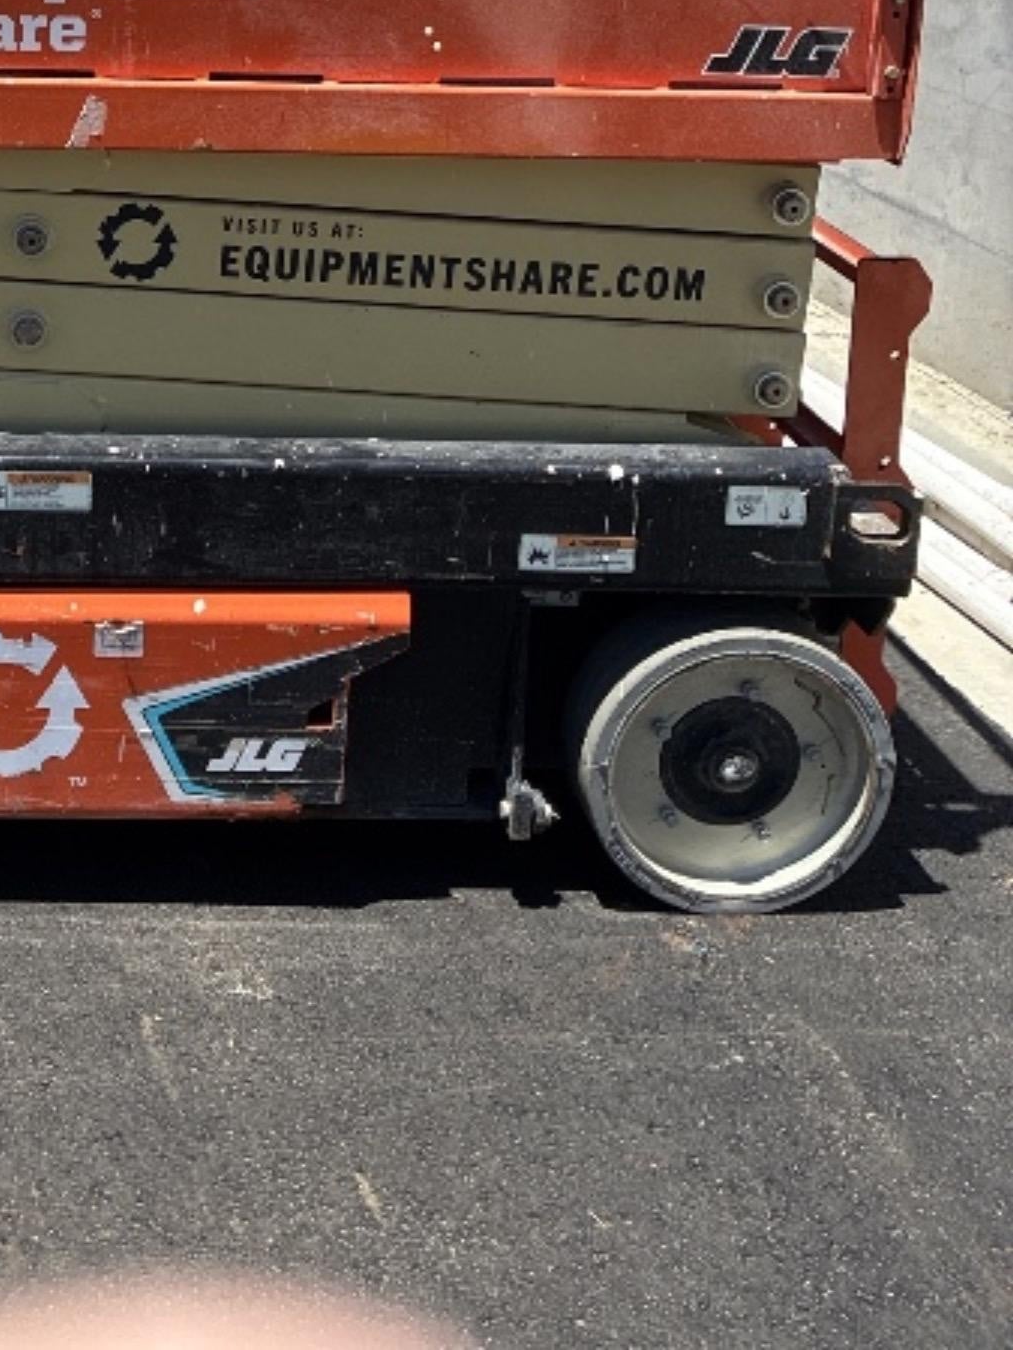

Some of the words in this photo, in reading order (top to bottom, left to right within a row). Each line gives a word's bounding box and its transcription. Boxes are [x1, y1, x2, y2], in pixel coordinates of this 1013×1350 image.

[701, 24, 854, 78] JLG
[221, 216, 281, 235] VISIT
[293, 221, 319, 238] US
[331, 222, 364, 239] AT:
[219, 245, 706, 301] EQUIPMENTSHARE.COM
[206, 738, 310, 772] JLG
